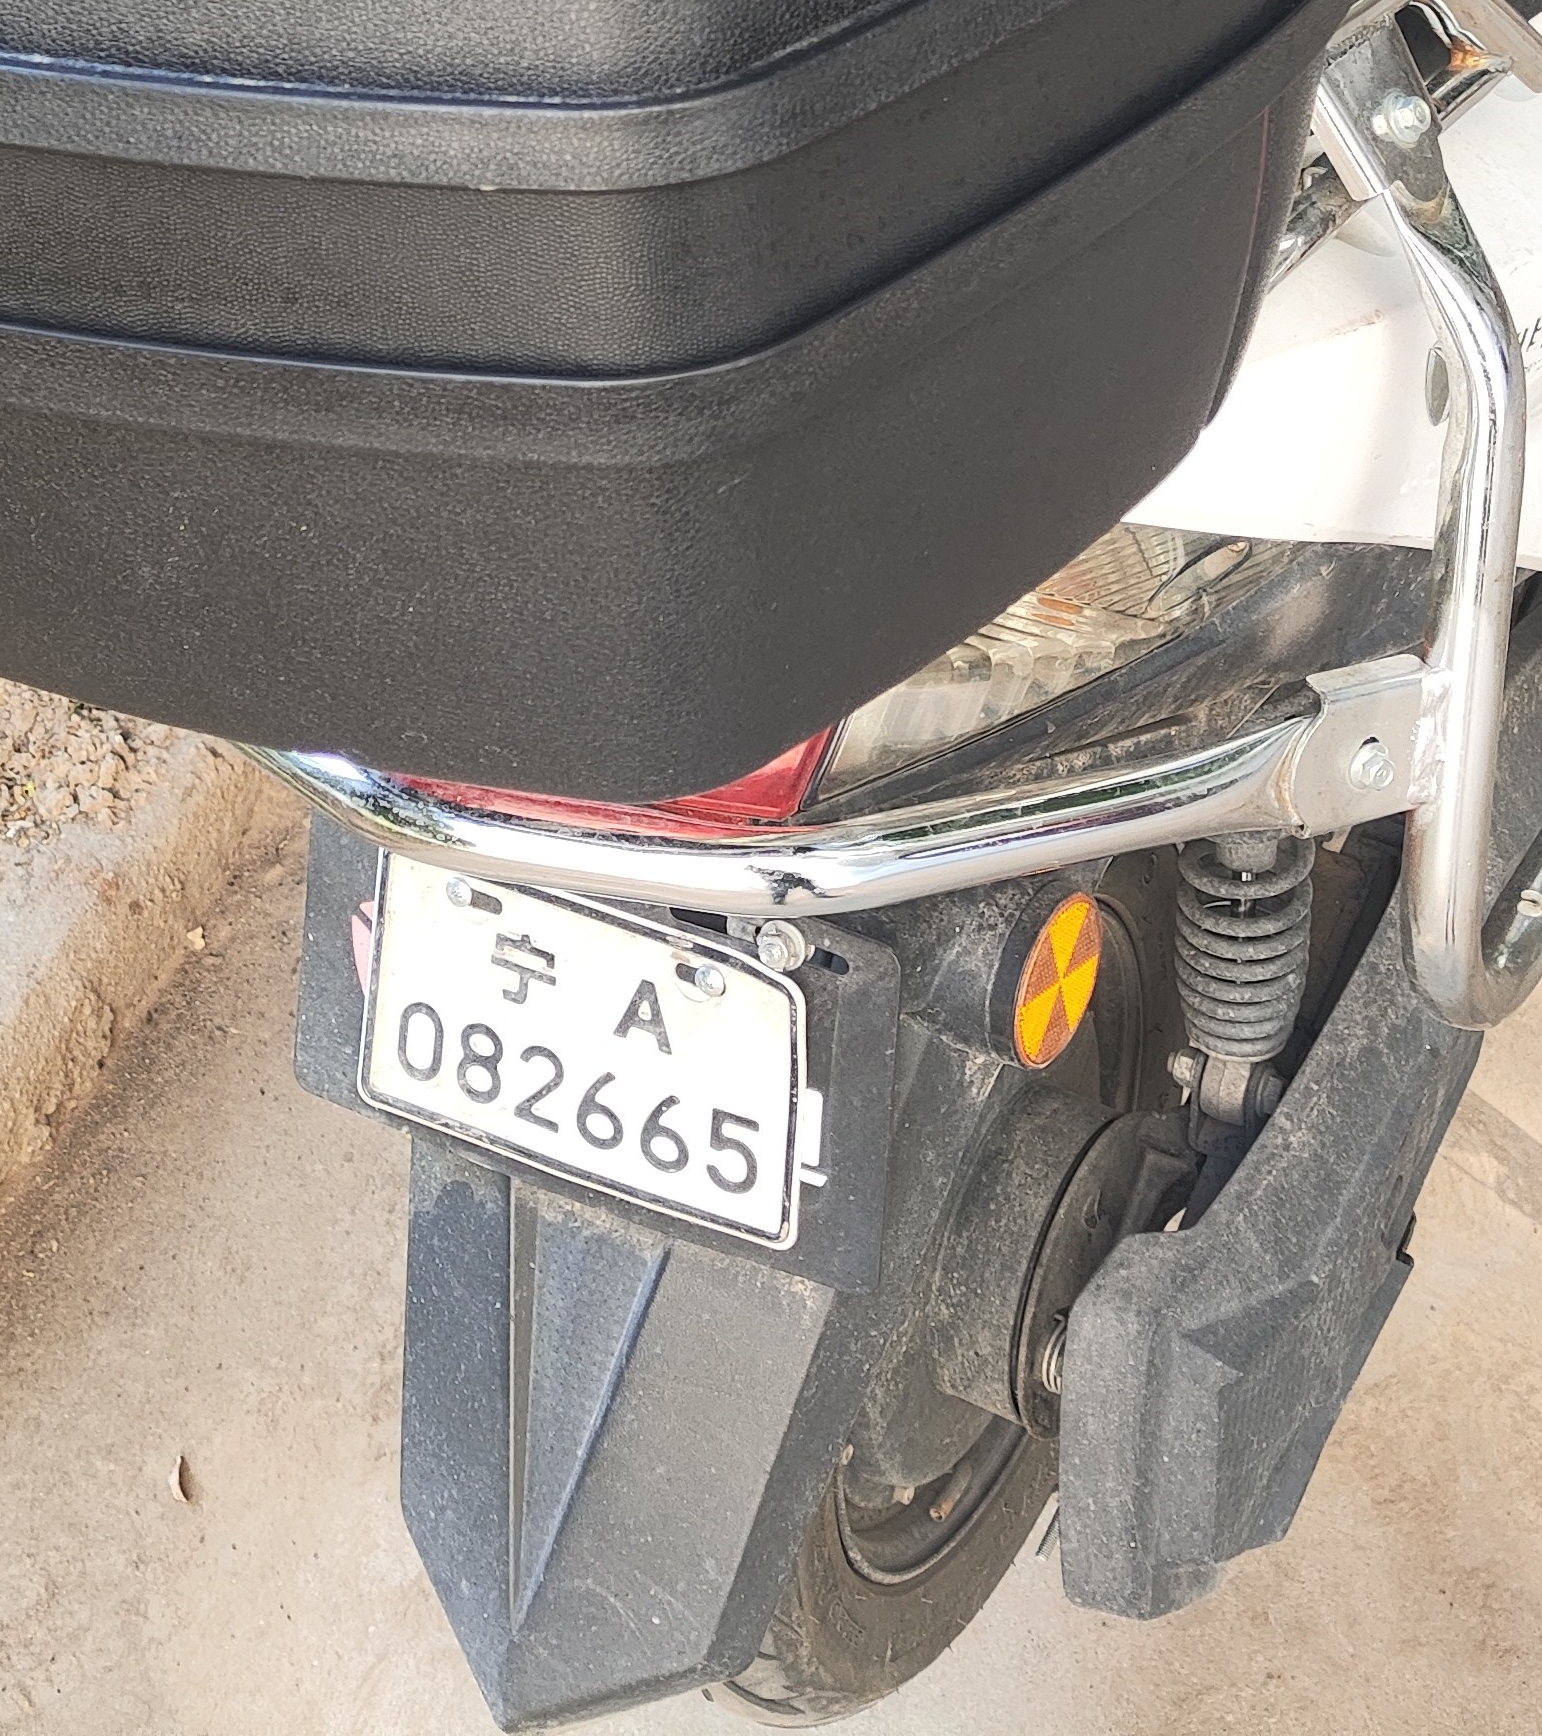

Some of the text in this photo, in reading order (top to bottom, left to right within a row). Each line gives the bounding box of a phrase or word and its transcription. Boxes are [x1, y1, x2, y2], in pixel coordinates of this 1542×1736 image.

[490, 932, 673, 1056] 宁 A
[397, 1001, 761, 1195] 082665
